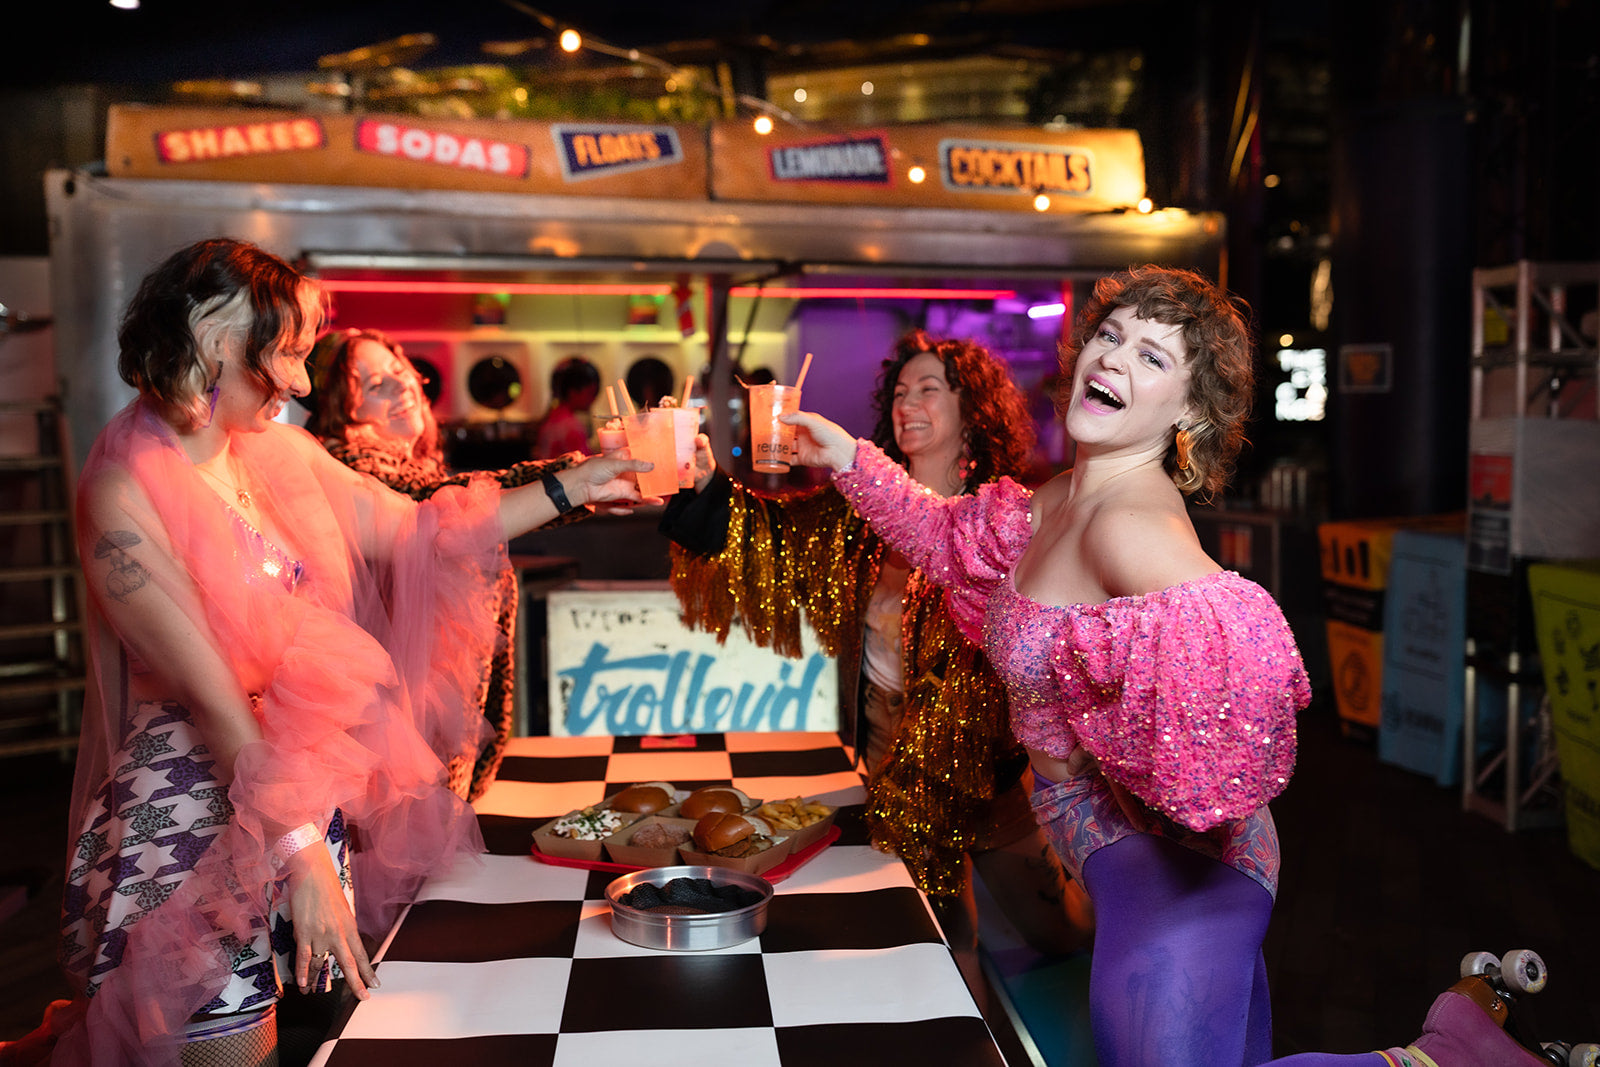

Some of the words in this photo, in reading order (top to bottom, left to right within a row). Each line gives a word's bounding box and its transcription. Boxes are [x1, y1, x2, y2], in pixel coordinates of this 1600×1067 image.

[163, 117, 318, 161] SHAKES
[376, 125, 511, 174] SODAS
[572, 131, 661, 167] FLOATS
[947, 148, 1091, 193] COCKTAILS
[757, 442, 789, 454] reuse
